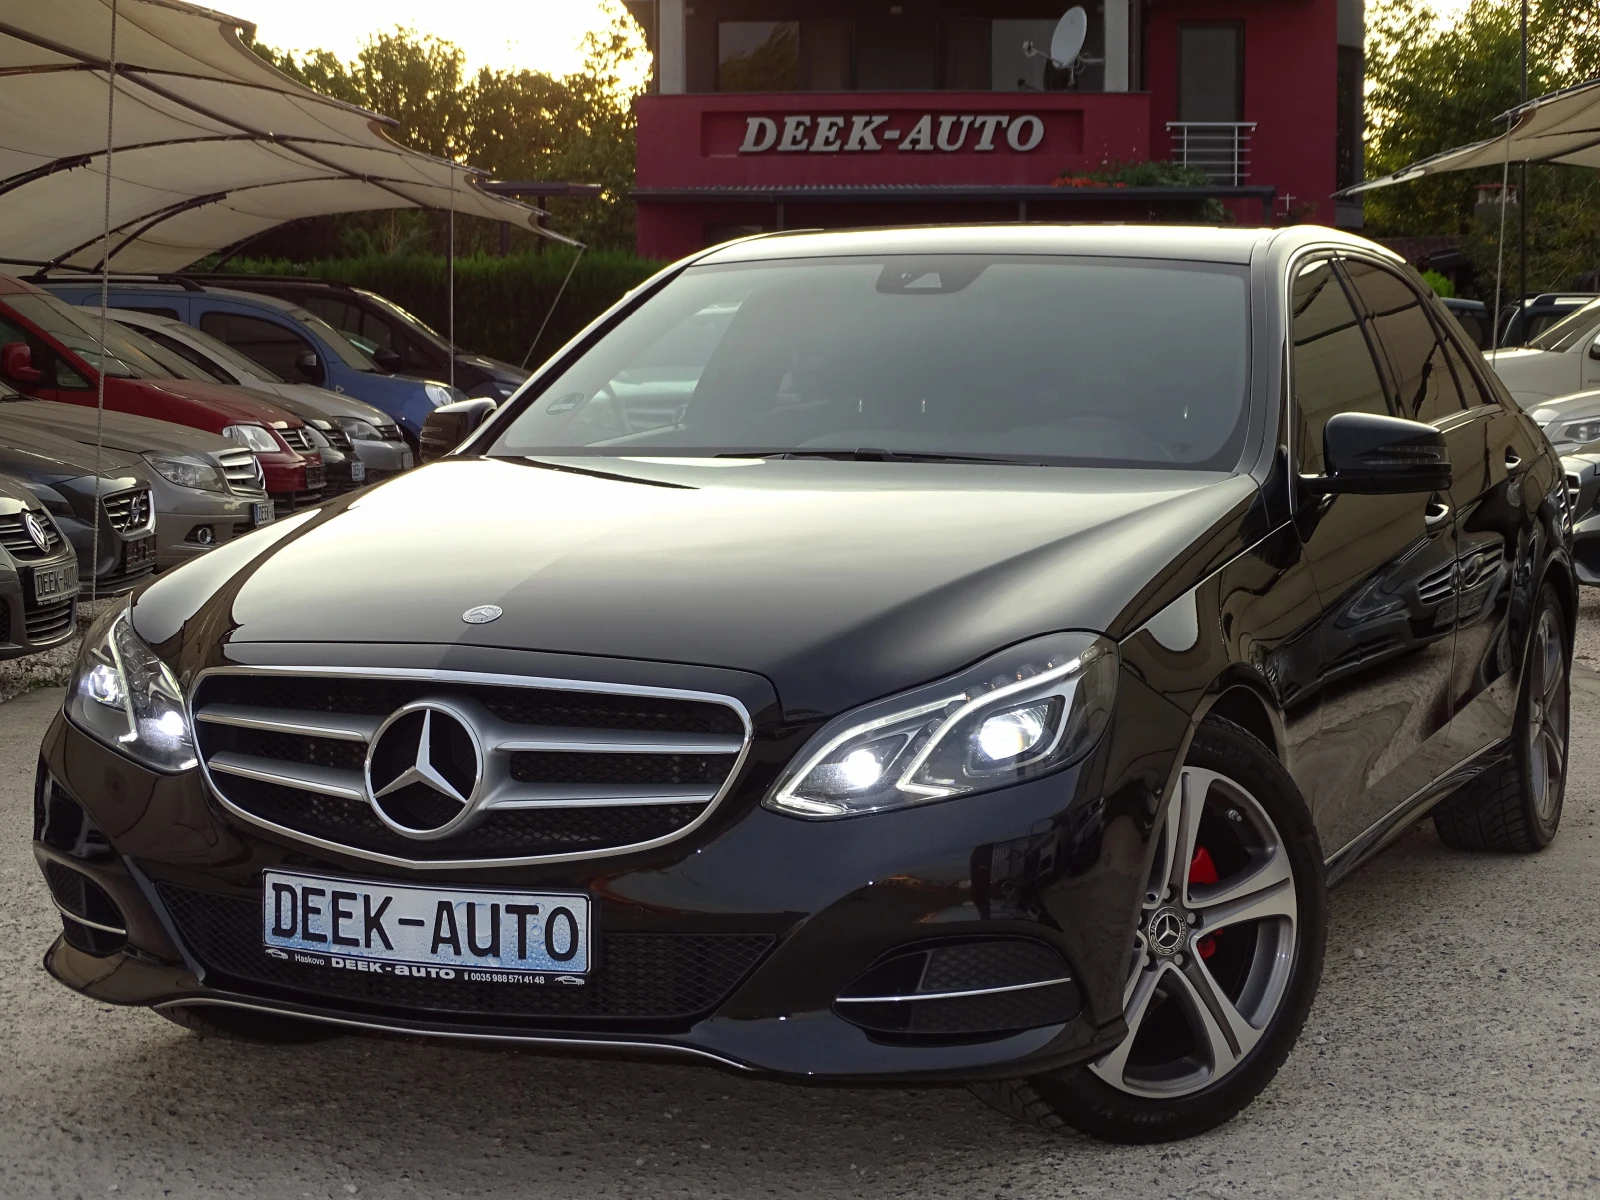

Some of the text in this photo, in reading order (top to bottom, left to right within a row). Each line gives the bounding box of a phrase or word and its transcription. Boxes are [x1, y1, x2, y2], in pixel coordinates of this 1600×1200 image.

[739, 115, 1044, 152] DEEK-AUTO
[271, 882, 579, 962] DEEK-AUTO
[294, 953, 325, 966] Haskovo
